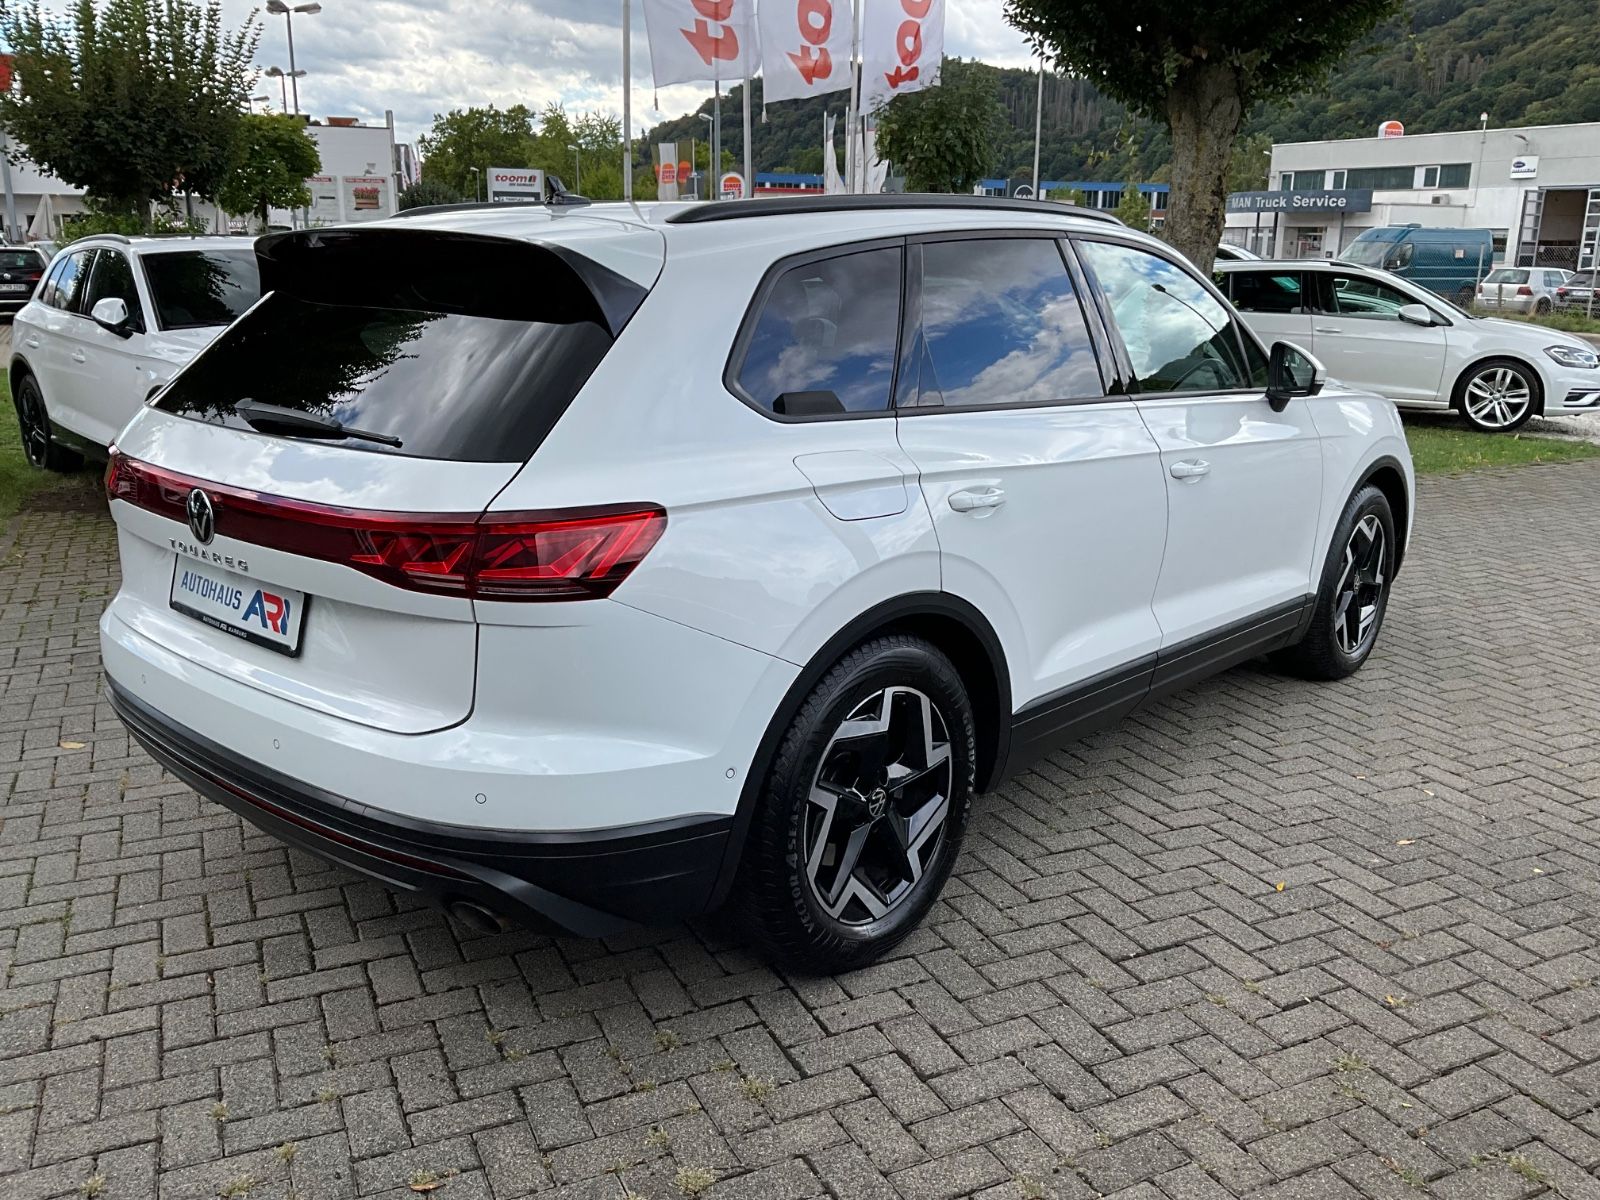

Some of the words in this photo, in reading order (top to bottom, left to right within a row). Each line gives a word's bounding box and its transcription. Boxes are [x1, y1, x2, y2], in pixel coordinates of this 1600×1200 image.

[495, 174, 528, 182] toom
[1231, 197, 1251, 208] MAN
[1256, 196, 1287, 208] Truck
[1292, 195, 1347, 207] Service
[168, 537, 249, 572] TOUAREG
[180, 570, 243, 610] AUTOHAUS
